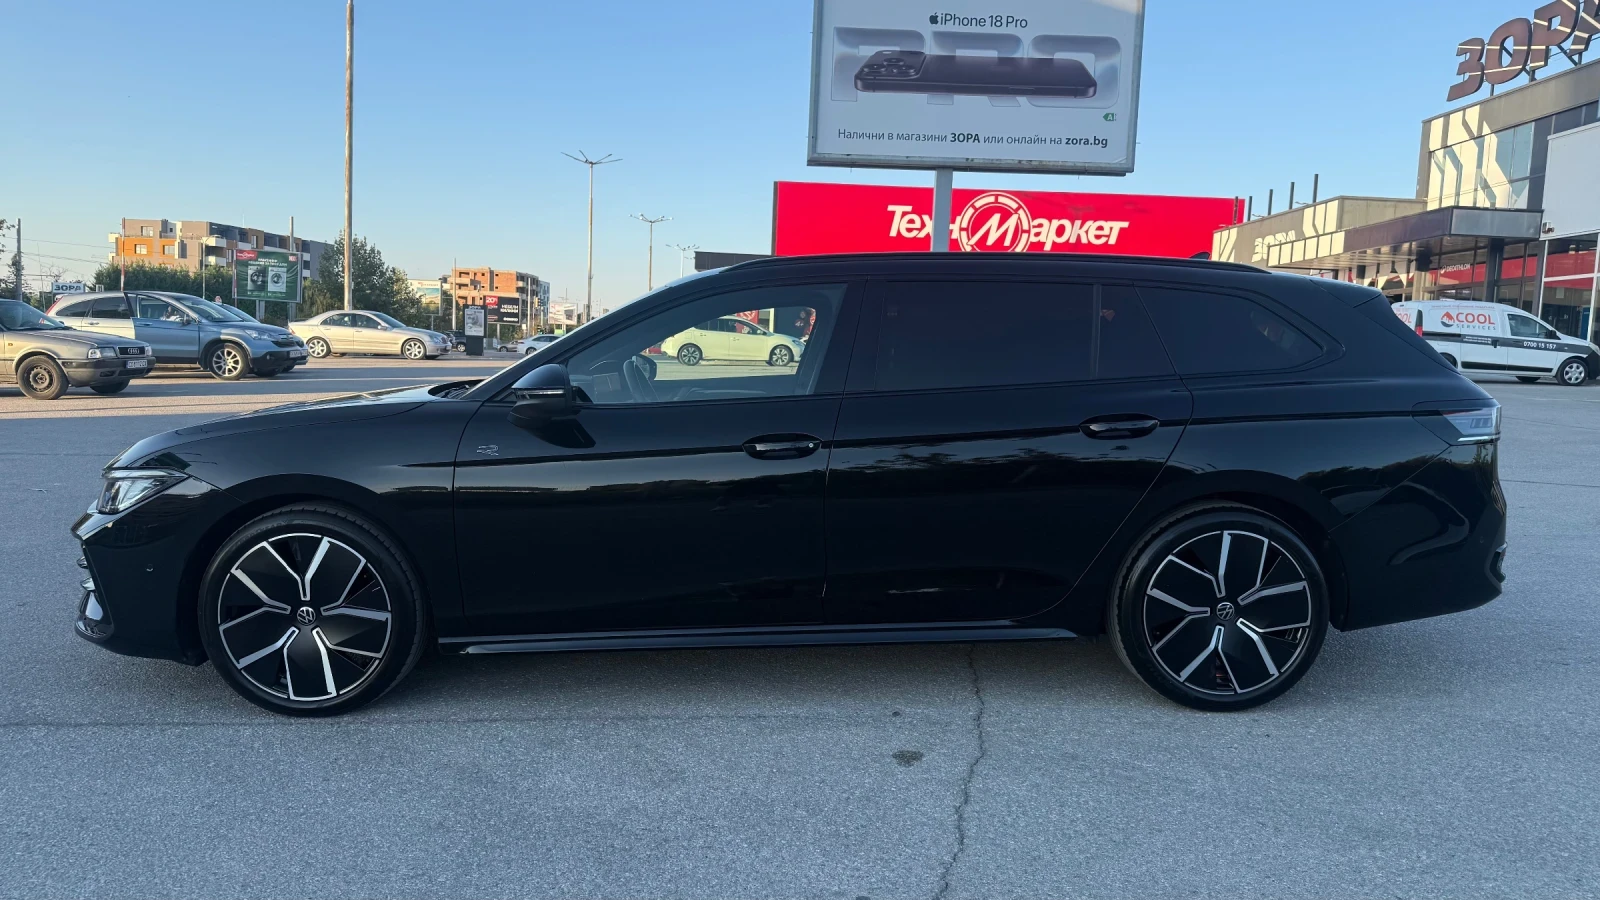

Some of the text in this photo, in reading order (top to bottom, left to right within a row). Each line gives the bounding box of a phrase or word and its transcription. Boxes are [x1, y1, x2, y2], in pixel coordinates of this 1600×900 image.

[940, 12, 1028, 28] iPhone 18 Pro
[838, 128, 1108, 148] Налични в магазини ЗОРА или онлайн на zora.bg
[54, 284, 82, 292] ЗОРА
[1455, 312, 1496, 325] COOL
[1456, 323, 1497, 331] SERVICES
